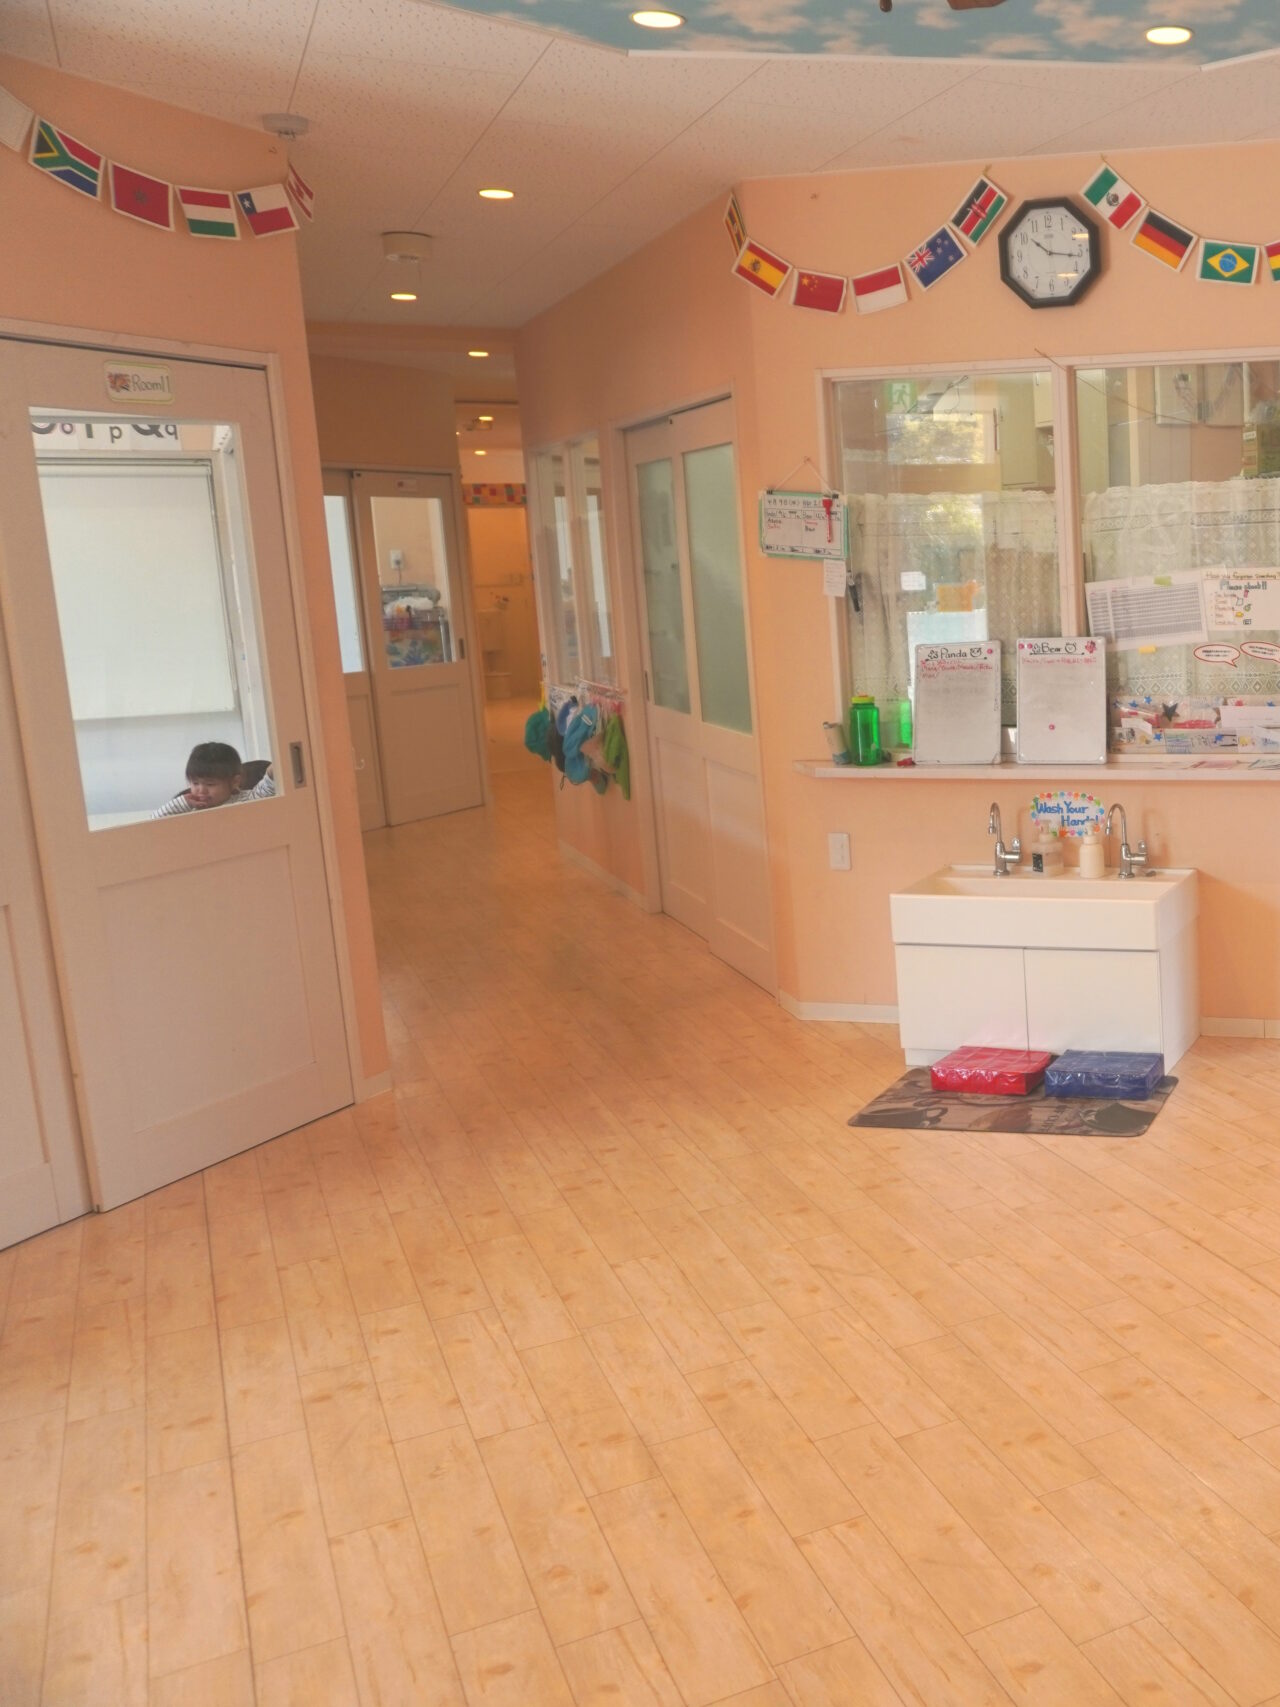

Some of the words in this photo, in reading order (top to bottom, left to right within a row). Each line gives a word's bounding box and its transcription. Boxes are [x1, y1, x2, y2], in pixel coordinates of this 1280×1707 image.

[1041, 642, 1062, 652] Bear
[940, 648, 967, 659] Panda
[1036, 801, 1063, 814] Wash
[1064, 800, 1089, 814] Your
[1061, 814, 1099, 827] Han!
